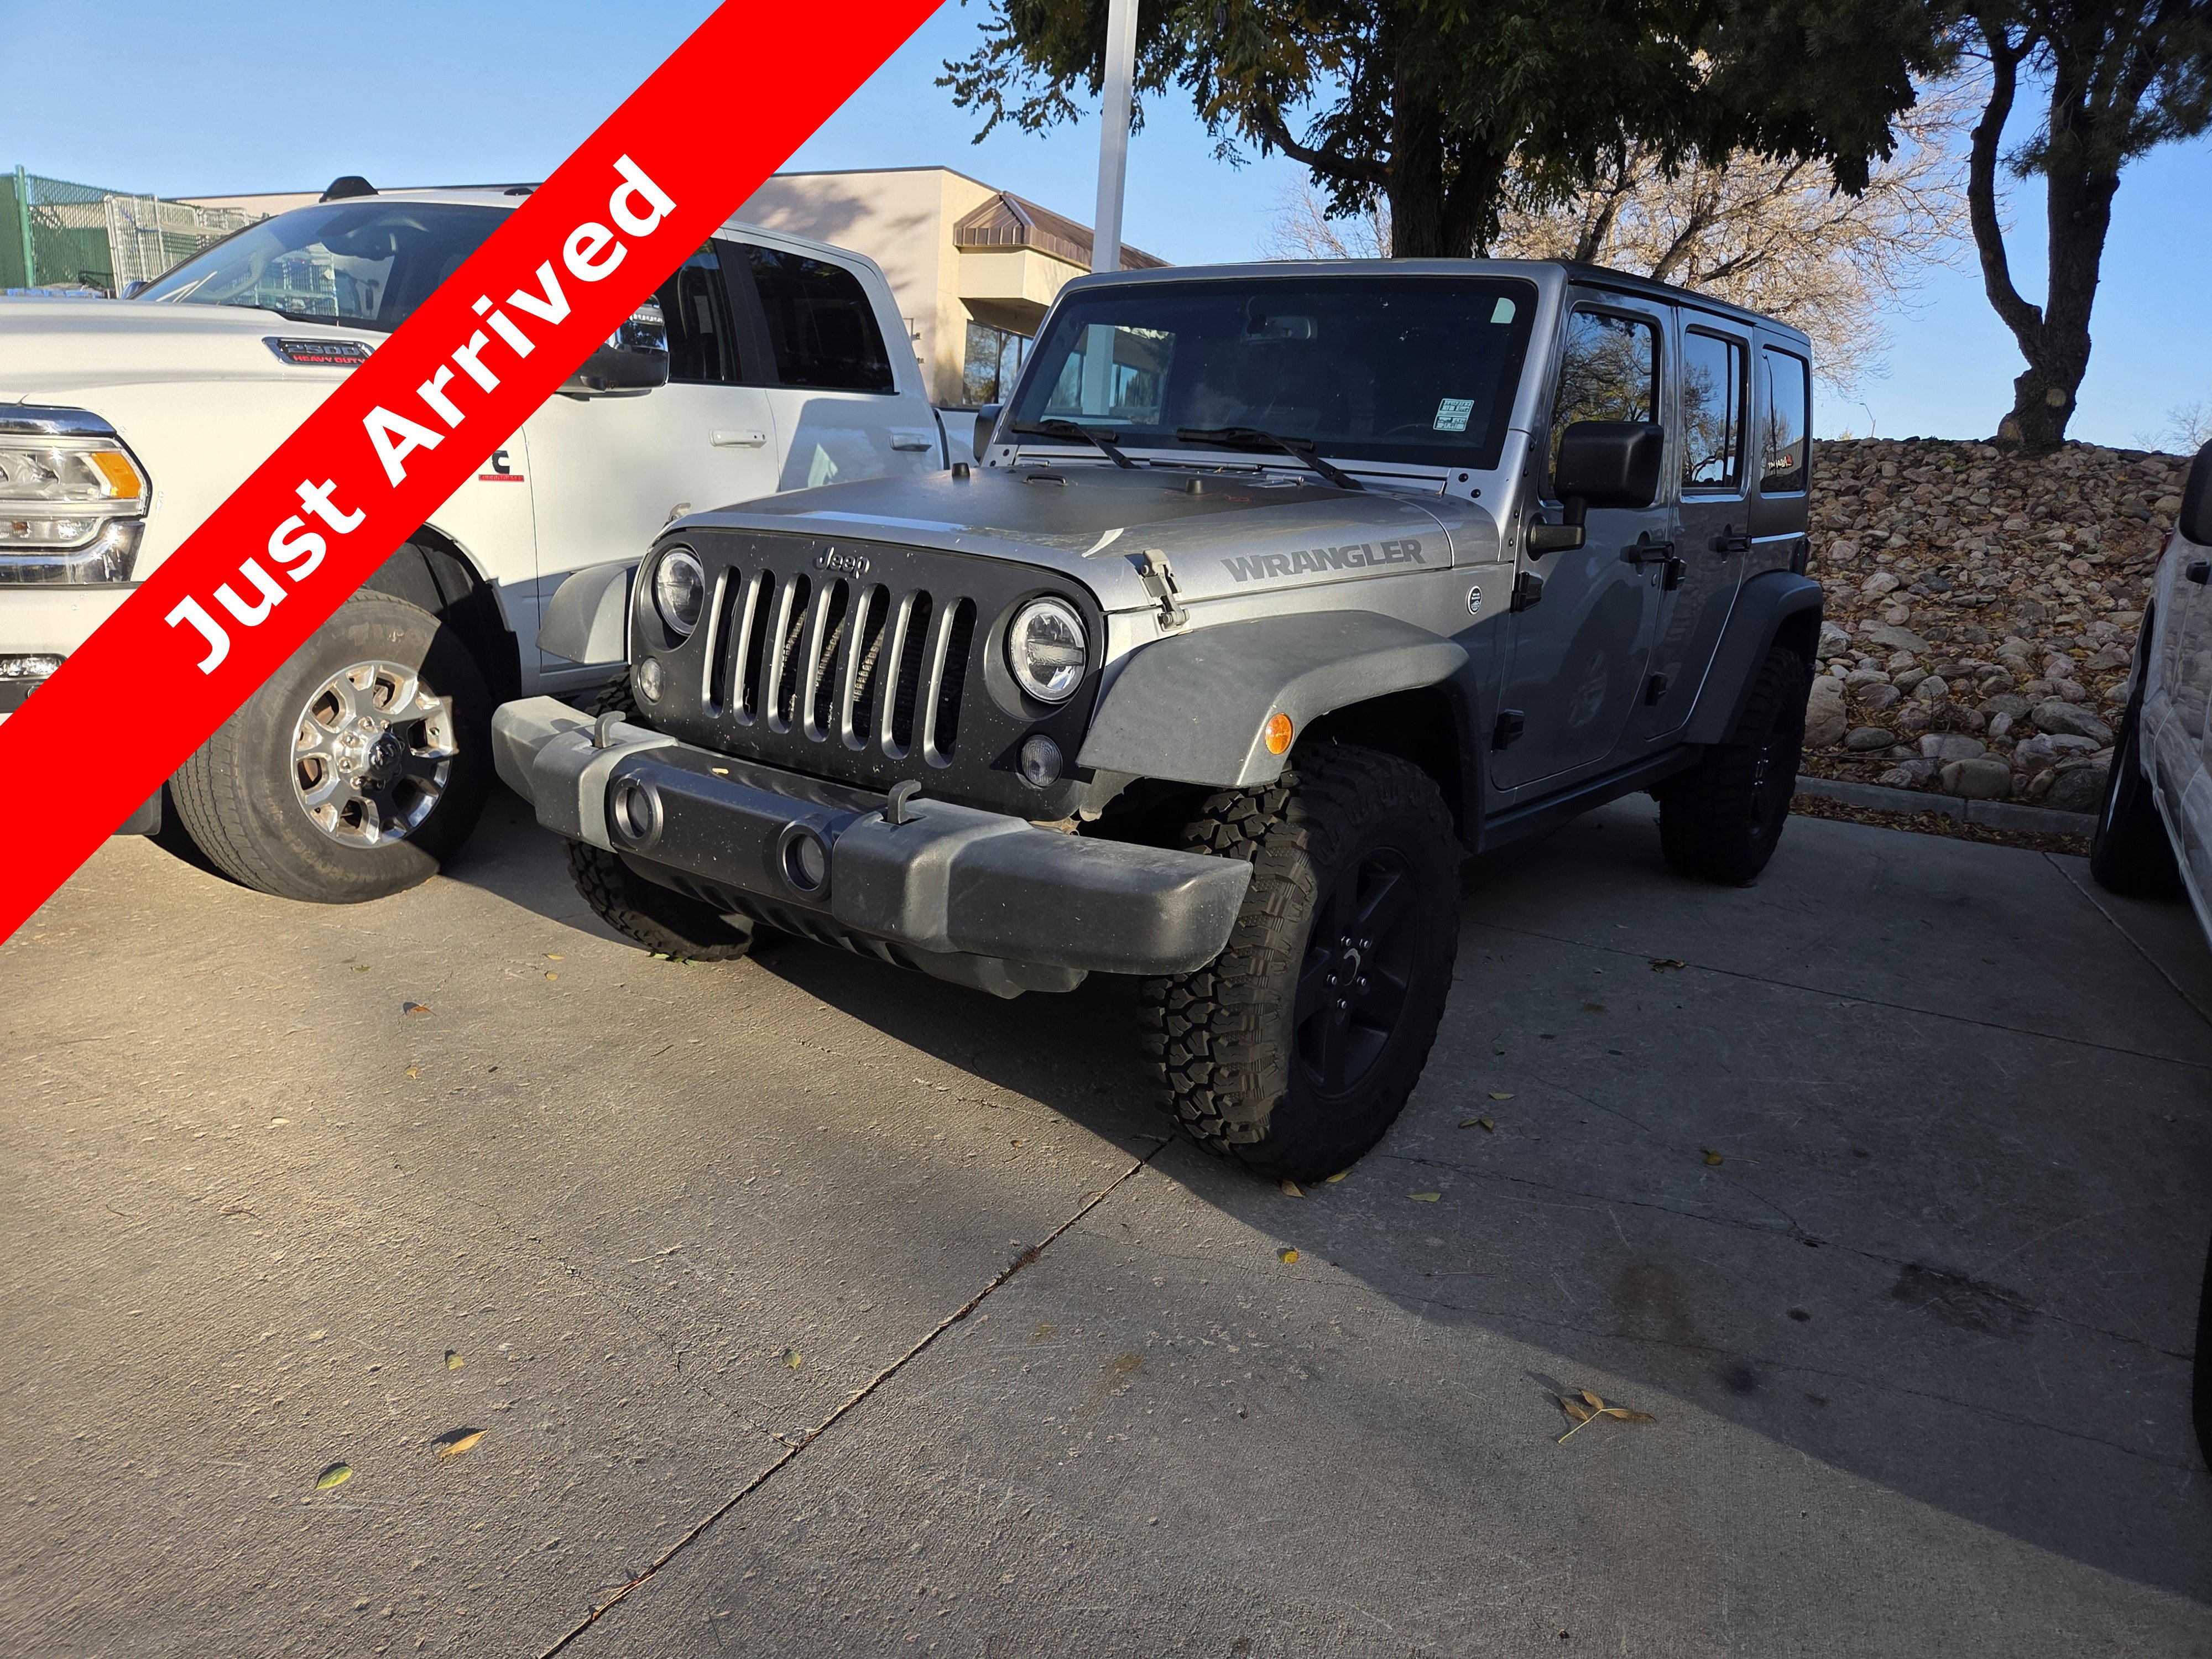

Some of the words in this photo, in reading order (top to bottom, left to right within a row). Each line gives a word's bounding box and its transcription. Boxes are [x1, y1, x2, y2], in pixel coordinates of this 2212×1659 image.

[285, 343, 360, 356] 2500
[816, 546, 870, 580] Jeep
[1220, 538, 1427, 582] WRANGLER
